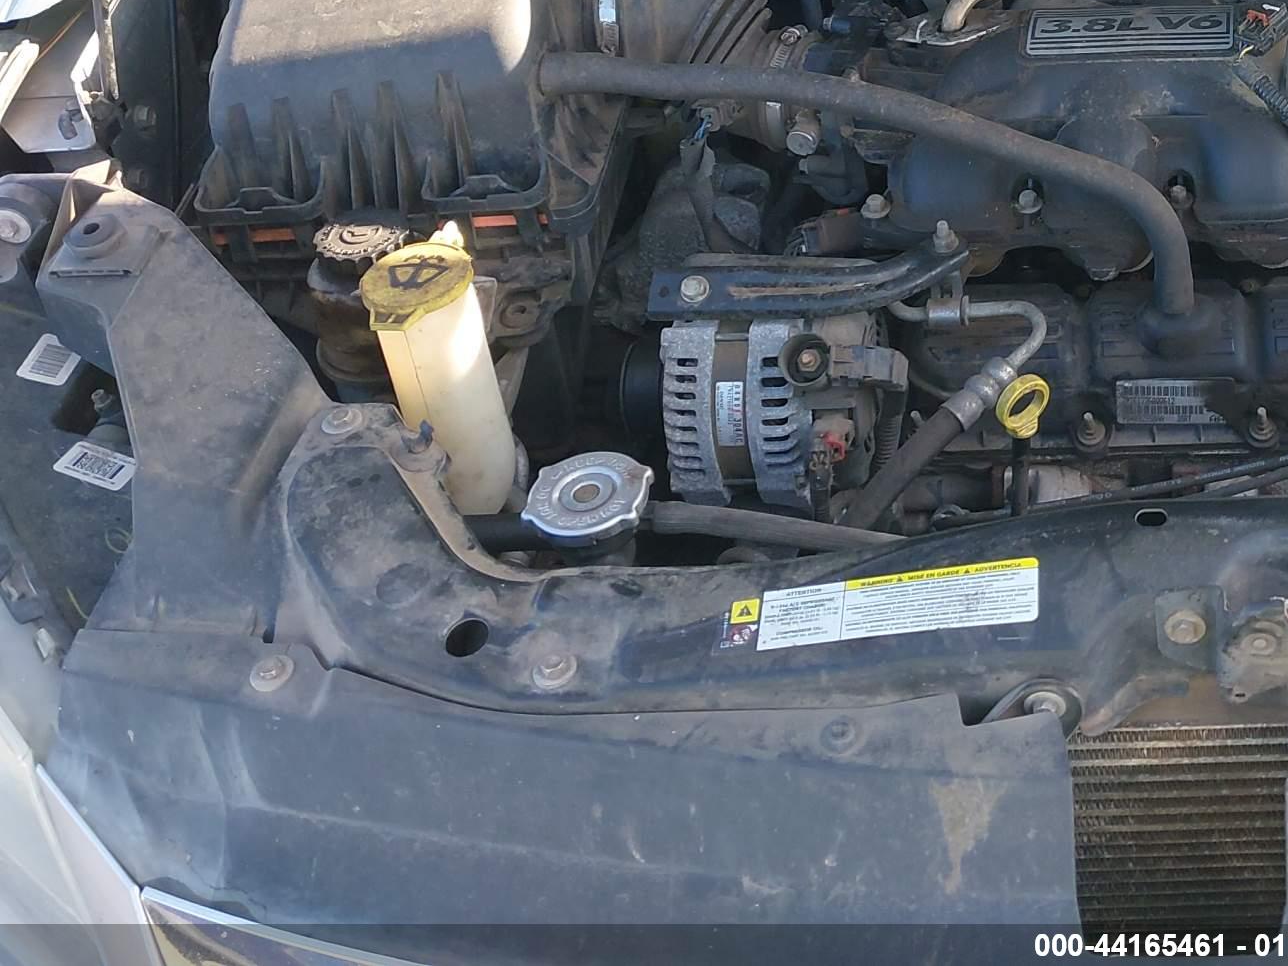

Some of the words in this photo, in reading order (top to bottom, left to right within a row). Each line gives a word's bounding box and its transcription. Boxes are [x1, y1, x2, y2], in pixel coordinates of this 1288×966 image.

[1040, 17, 1149, 34] 3.8L
[1155, 14, 1223, 30] V6
[907, 573, 925, 581] MISE
[936, 569, 961, 578] GARDE
